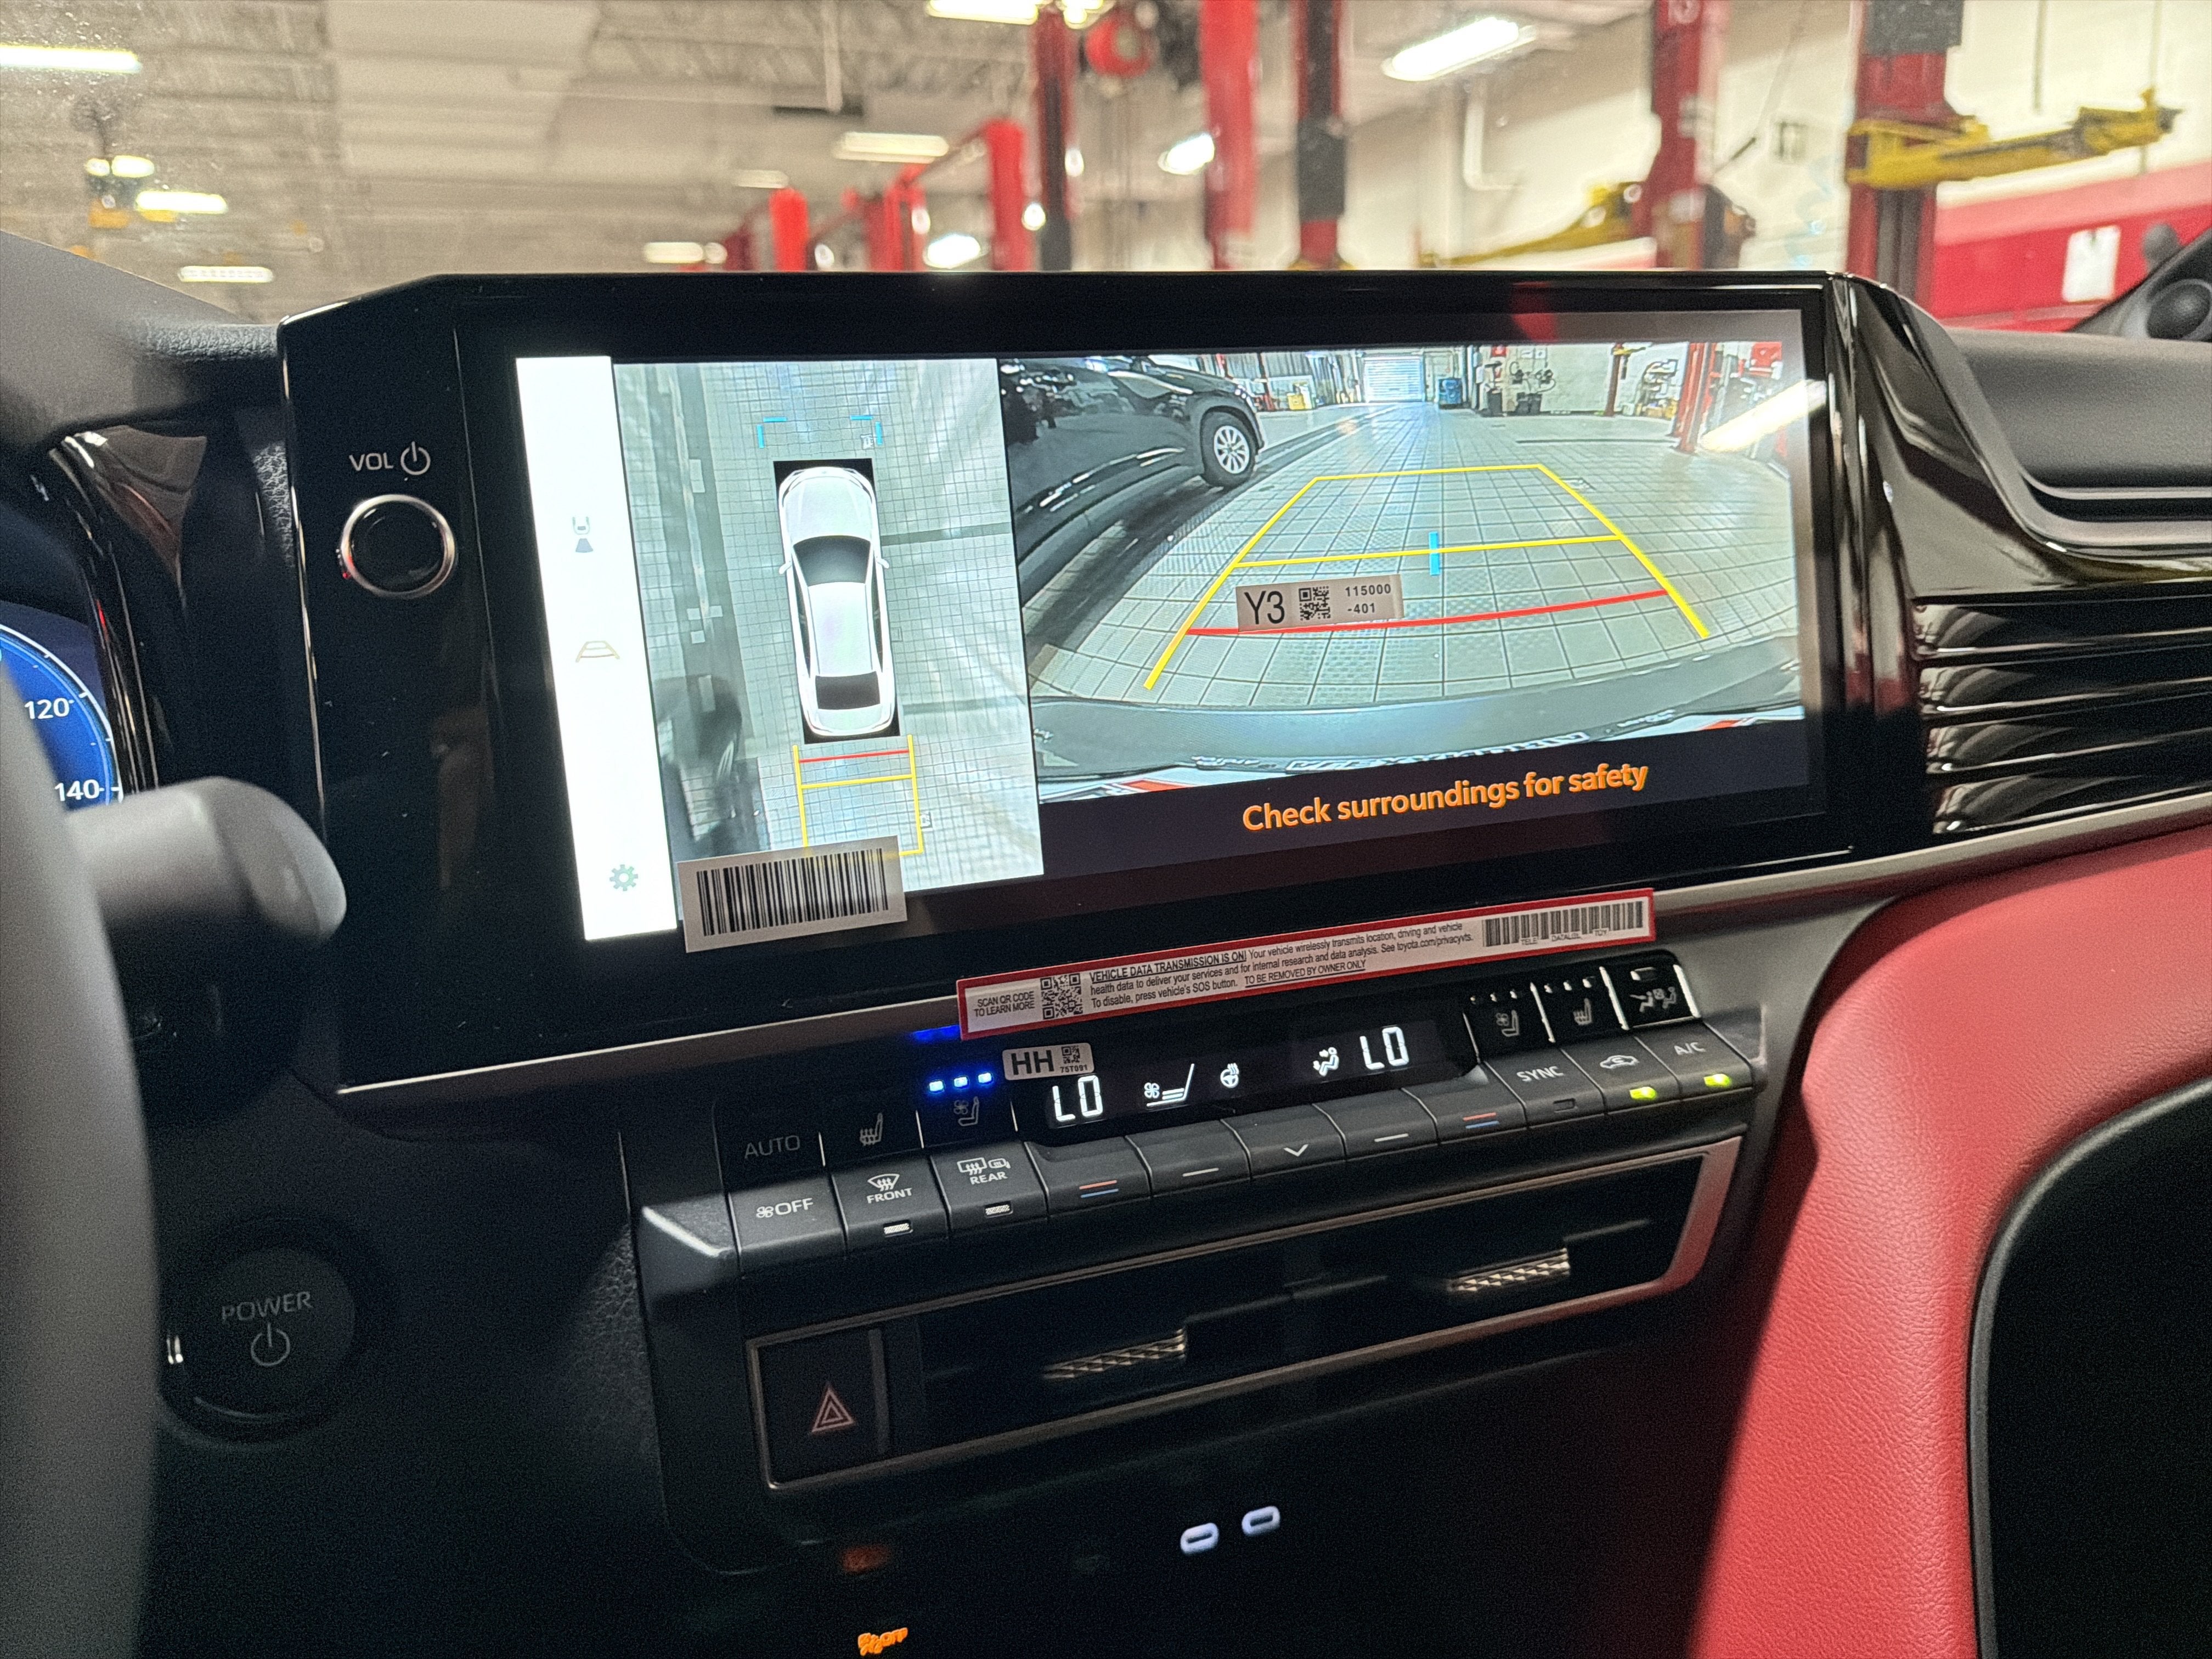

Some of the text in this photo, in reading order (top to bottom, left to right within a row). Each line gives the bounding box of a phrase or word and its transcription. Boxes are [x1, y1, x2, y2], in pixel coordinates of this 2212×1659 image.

[348, 452, 394, 471] VOL
[1345, 584, 1391, 597] 115000
[1244, 590, 1285, 625] Y3
[1347, 603, 1375, 614] -401
[24, 697, 70, 720] 120
[54, 779, 100, 802] 140
[1243, 763, 1648, 832] Check surroundings for safety
[1089, 922, 1462, 983] VEHICLE DATA TRANSMISSION IS ON! Your vehicle wirelessly transmits location, driving and vehicle
[1090, 984, 1114, 996] health
[1116, 980, 1133, 991] data
[1136, 980, 1144, 988] to
[1146, 975, 1171, 988] deliver
[1173, 973, 1190, 985] your
[1192, 968, 1223, 980] services
[1224, 964, 1239, 974] and
[1240, 963, 1250, 972] for
[1252, 961, 1279, 972] internal
[1282, 955, 1313, 967] research
[1315, 952, 1329, 962] and
[1330, 949, 1346, 960] data
[1348, 946, 1379, 958] analysis.
[1381, 943, 1395, 953] See
[1091, 959, 1366, 1008] To disable, press vehicle's SOS button. TO BE REMOVED BY OWNER ONLY
[974, 1000, 1035, 1017] TO LEARN MORE
[978, 996, 998, 1007] SCAN
[1013, 991, 1034, 1002] CODE
[1359, 1026, 1409, 1070] LO
[1674, 1042, 1706, 1055] A/C
[1011, 1050, 1054, 1075] HH
[1060, 1064, 1087, 1073] 75T091
[1516, 1066, 1564, 1082] SYNC
[1052, 1075, 1103, 1122] LO
[744, 1135, 801, 1159] AUTO
[970, 1171, 1008, 1185] REAR
[775, 1198, 814, 1216] OFF
[867, 1187, 913, 1204] FRONT
[222, 1291, 313, 1321] POWER
